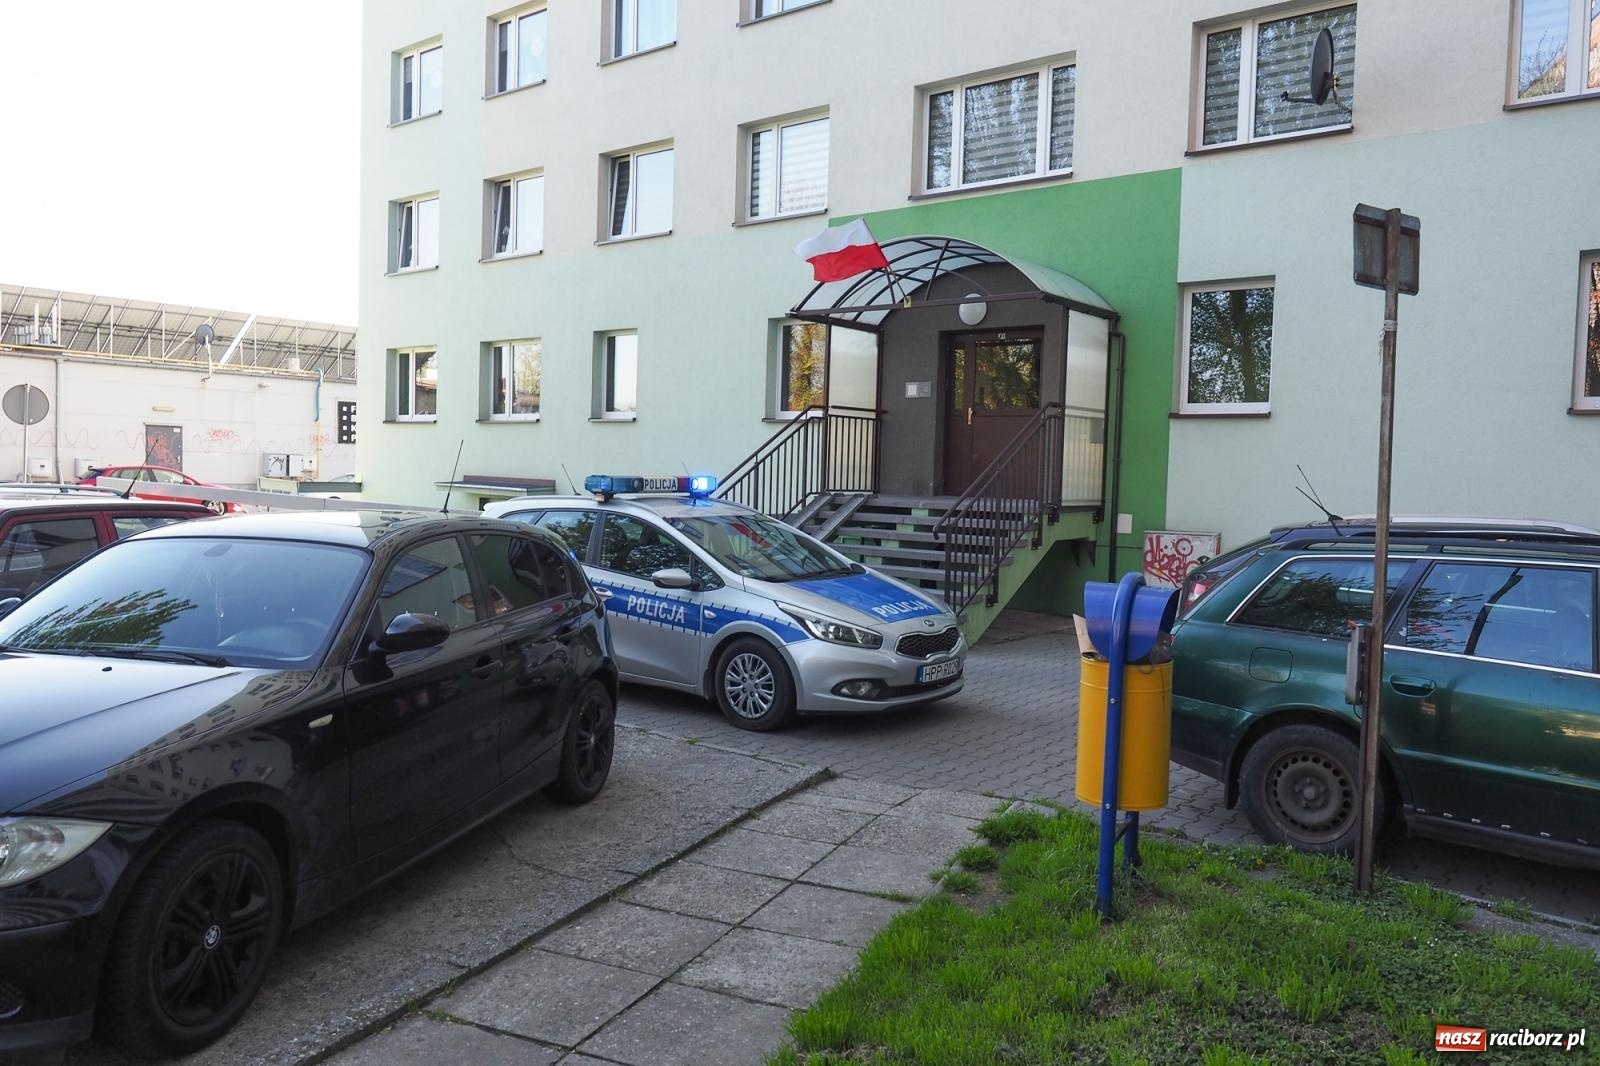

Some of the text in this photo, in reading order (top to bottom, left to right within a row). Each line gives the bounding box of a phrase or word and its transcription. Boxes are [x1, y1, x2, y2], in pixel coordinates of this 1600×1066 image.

[644, 478, 677, 490] POLICJA
[627, 594, 685, 624] POLICJA
[871, 600, 934, 618] POLICJA
[924, 664, 943, 681] HPP
